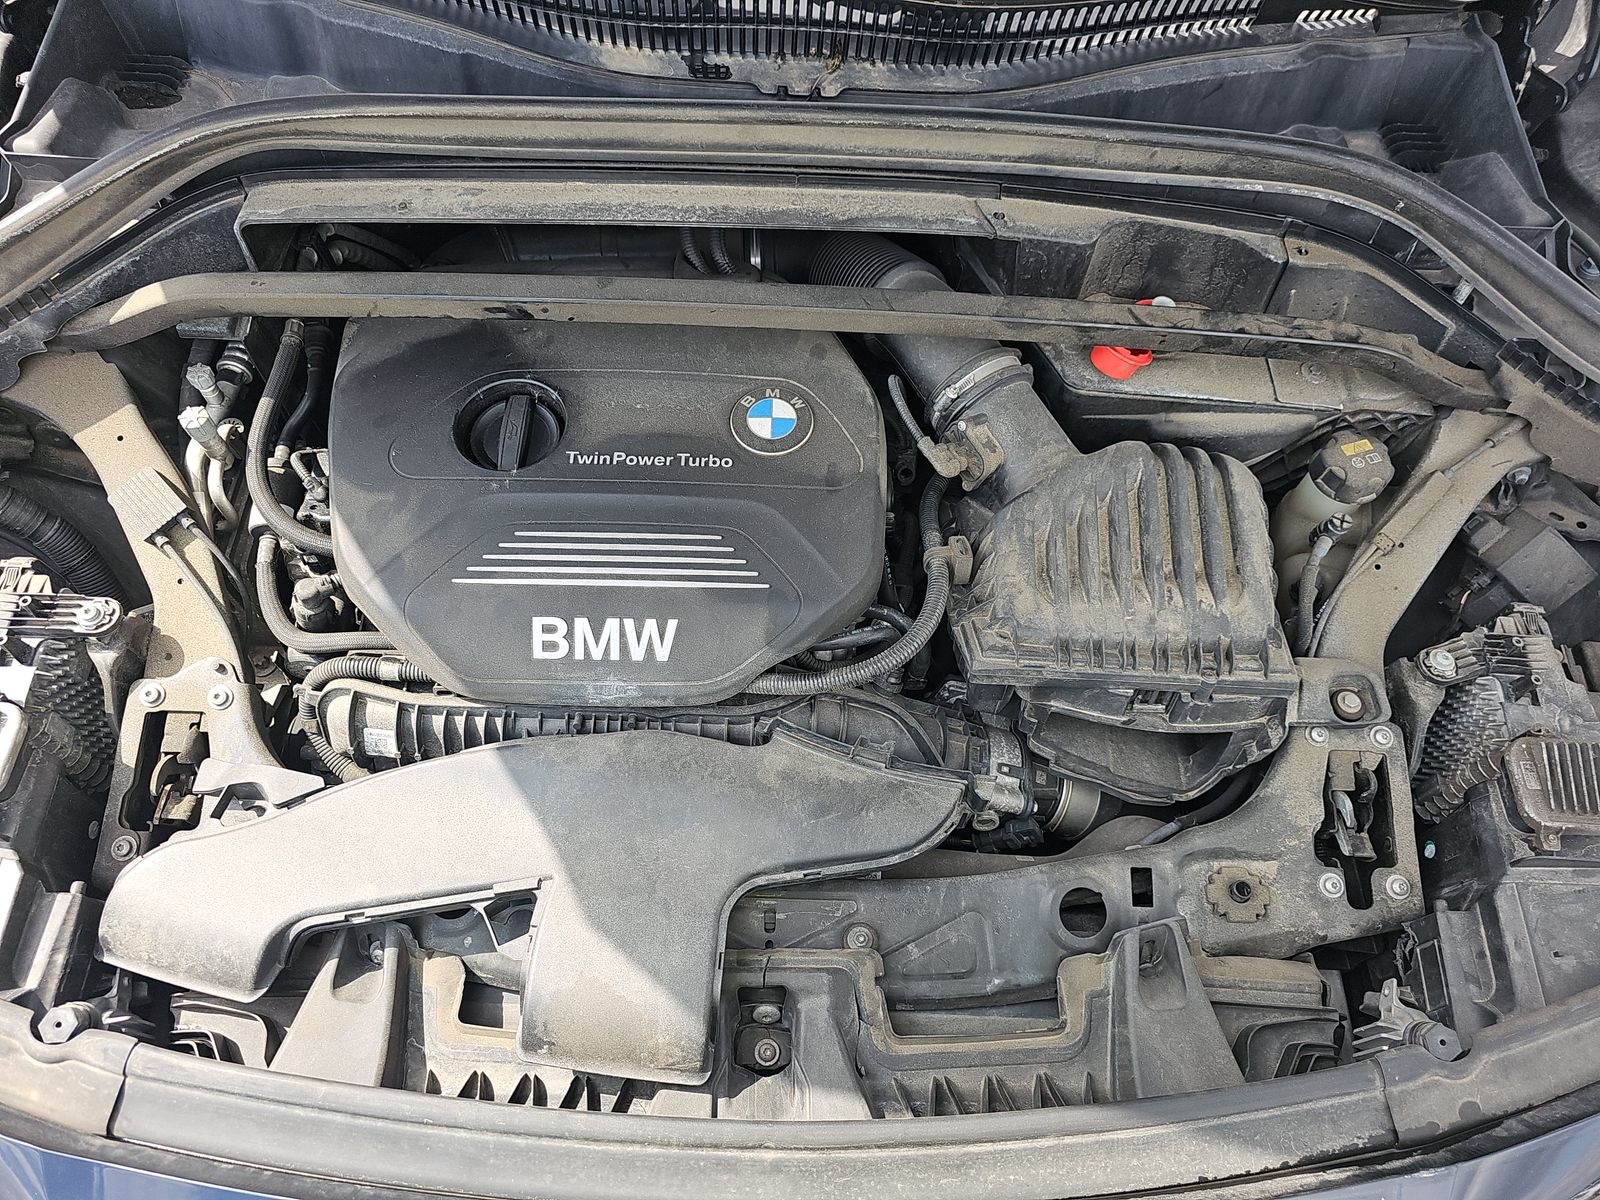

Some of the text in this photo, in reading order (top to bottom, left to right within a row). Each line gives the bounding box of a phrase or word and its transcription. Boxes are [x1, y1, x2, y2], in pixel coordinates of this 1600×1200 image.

[740, 388, 806, 409] BMW
[676, 453, 733, 468] Turbo
[532, 616, 679, 662] BMW
